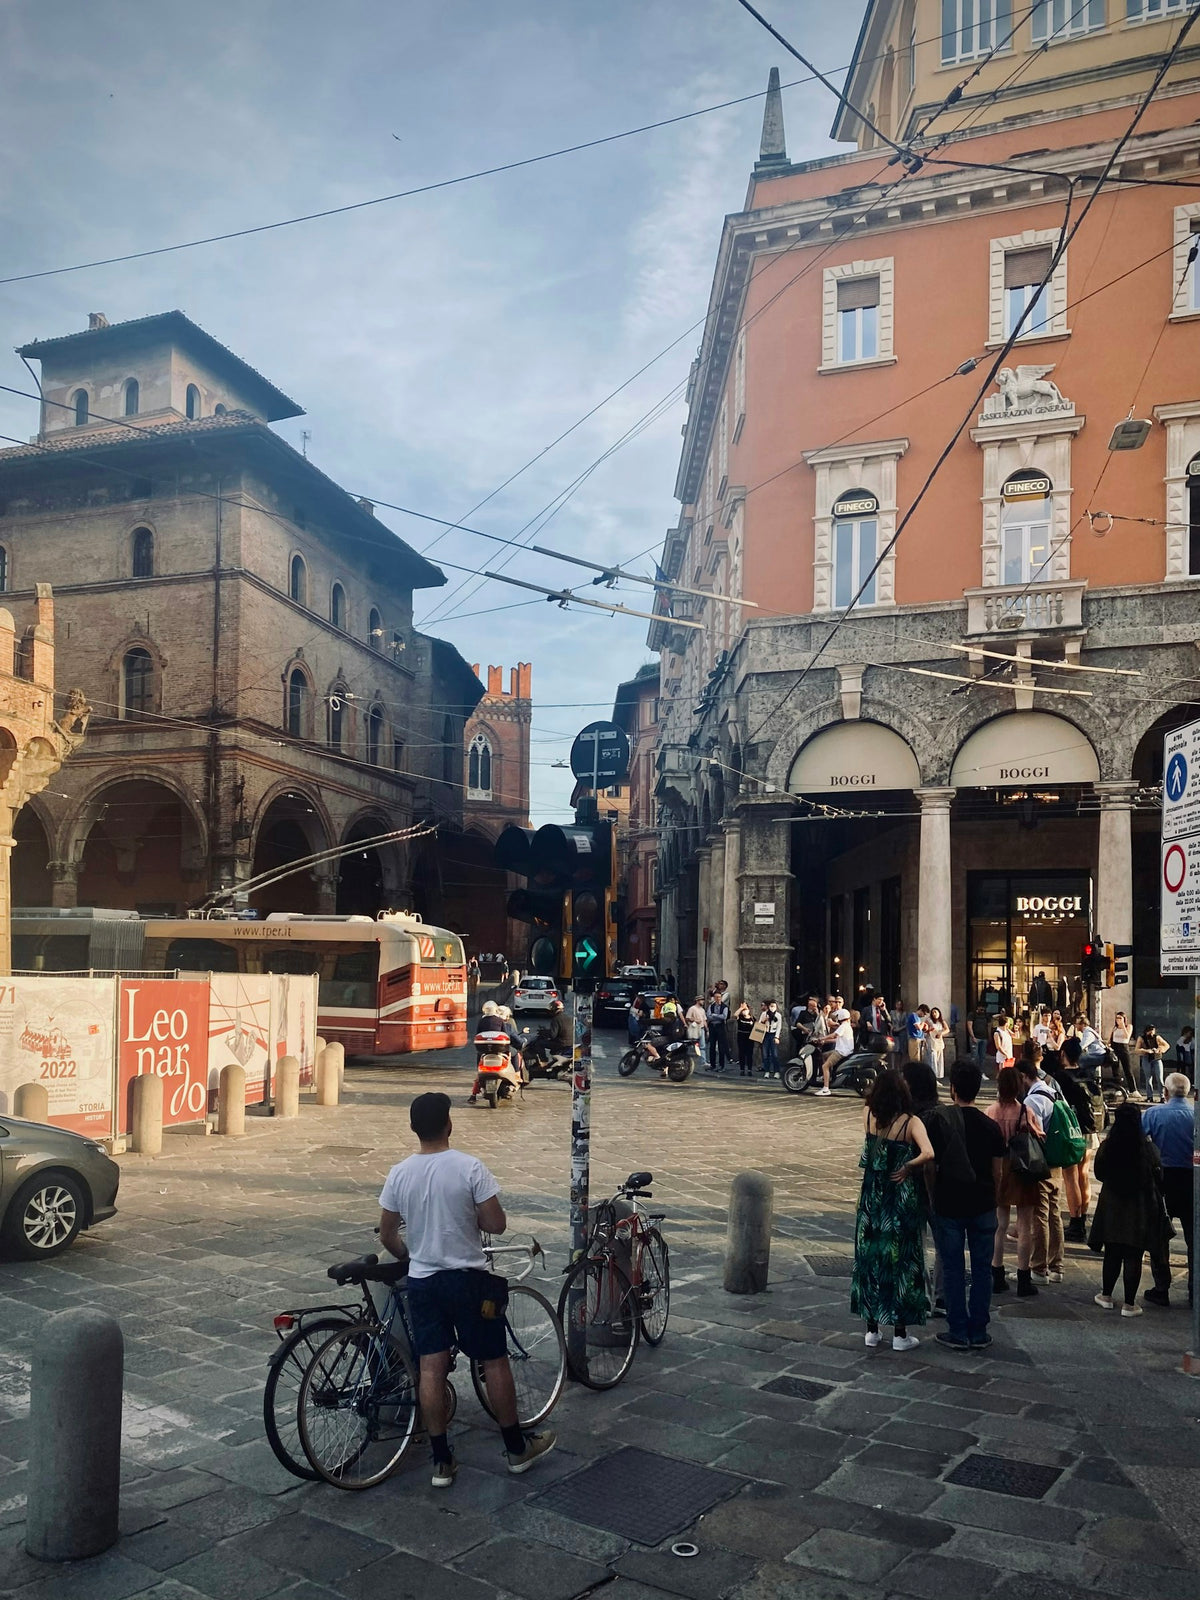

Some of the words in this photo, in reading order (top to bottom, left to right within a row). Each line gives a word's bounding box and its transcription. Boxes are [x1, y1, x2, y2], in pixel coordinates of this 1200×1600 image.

[980, 408, 1032, 421] ASSICURAZIONI
[1035, 403, 1073, 414] GENERALI
[1008, 481, 1046, 493] FINECO
[838, 501, 873, 513] FINECO
[1000, 766, 1050, 779] BOGGI
[830, 775, 876, 786] BOGGI
[1016, 896, 1082, 911] BOGGI
[233, 924, 292, 938] www.tper.it
[423, 981, 461, 994] www.tper.it
[124, 988, 188, 1043] Leo
[40, 1060, 77, 1080] 2022
[79, 1102, 105, 1113] STORIA
